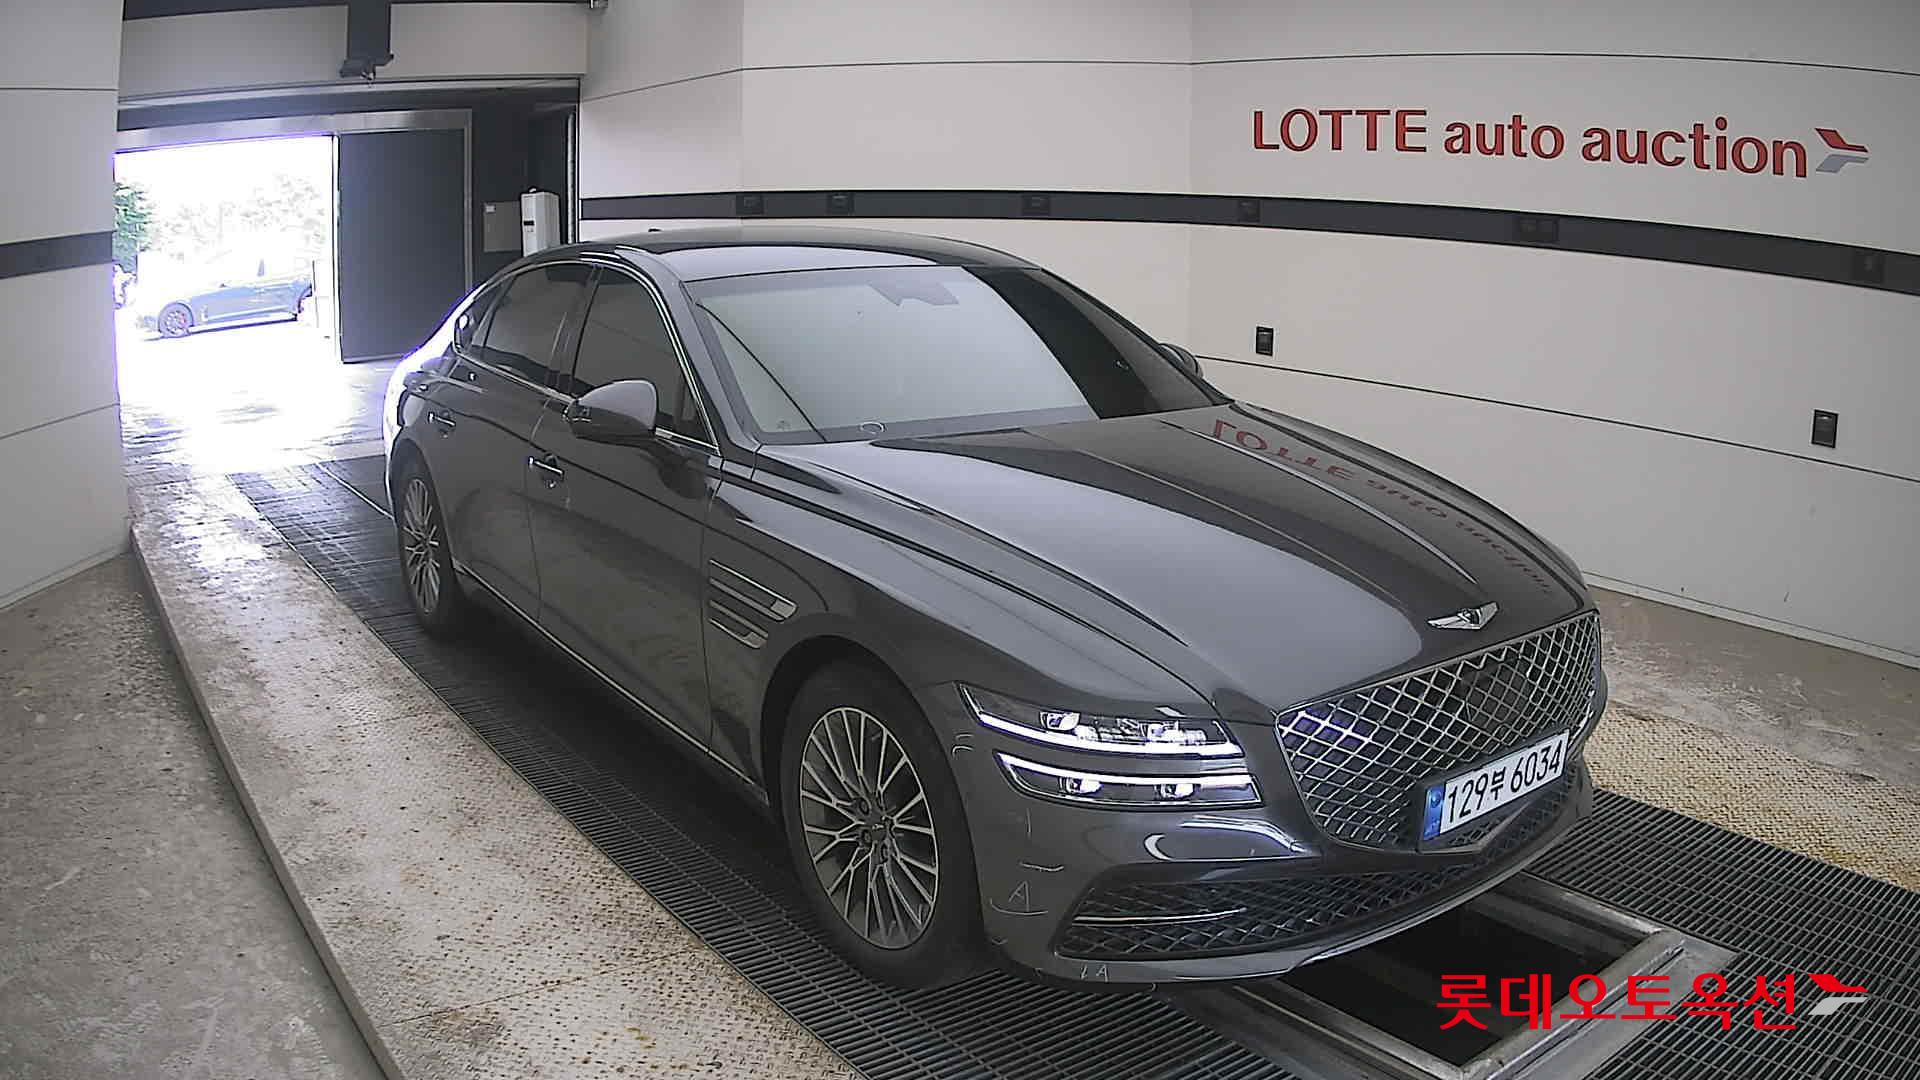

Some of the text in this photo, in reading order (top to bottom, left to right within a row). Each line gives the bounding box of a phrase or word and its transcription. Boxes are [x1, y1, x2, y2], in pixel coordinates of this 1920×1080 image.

[1253, 109, 1808, 178] LOTTE auto auction
[1448, 740, 1563, 824] 129부 6034
